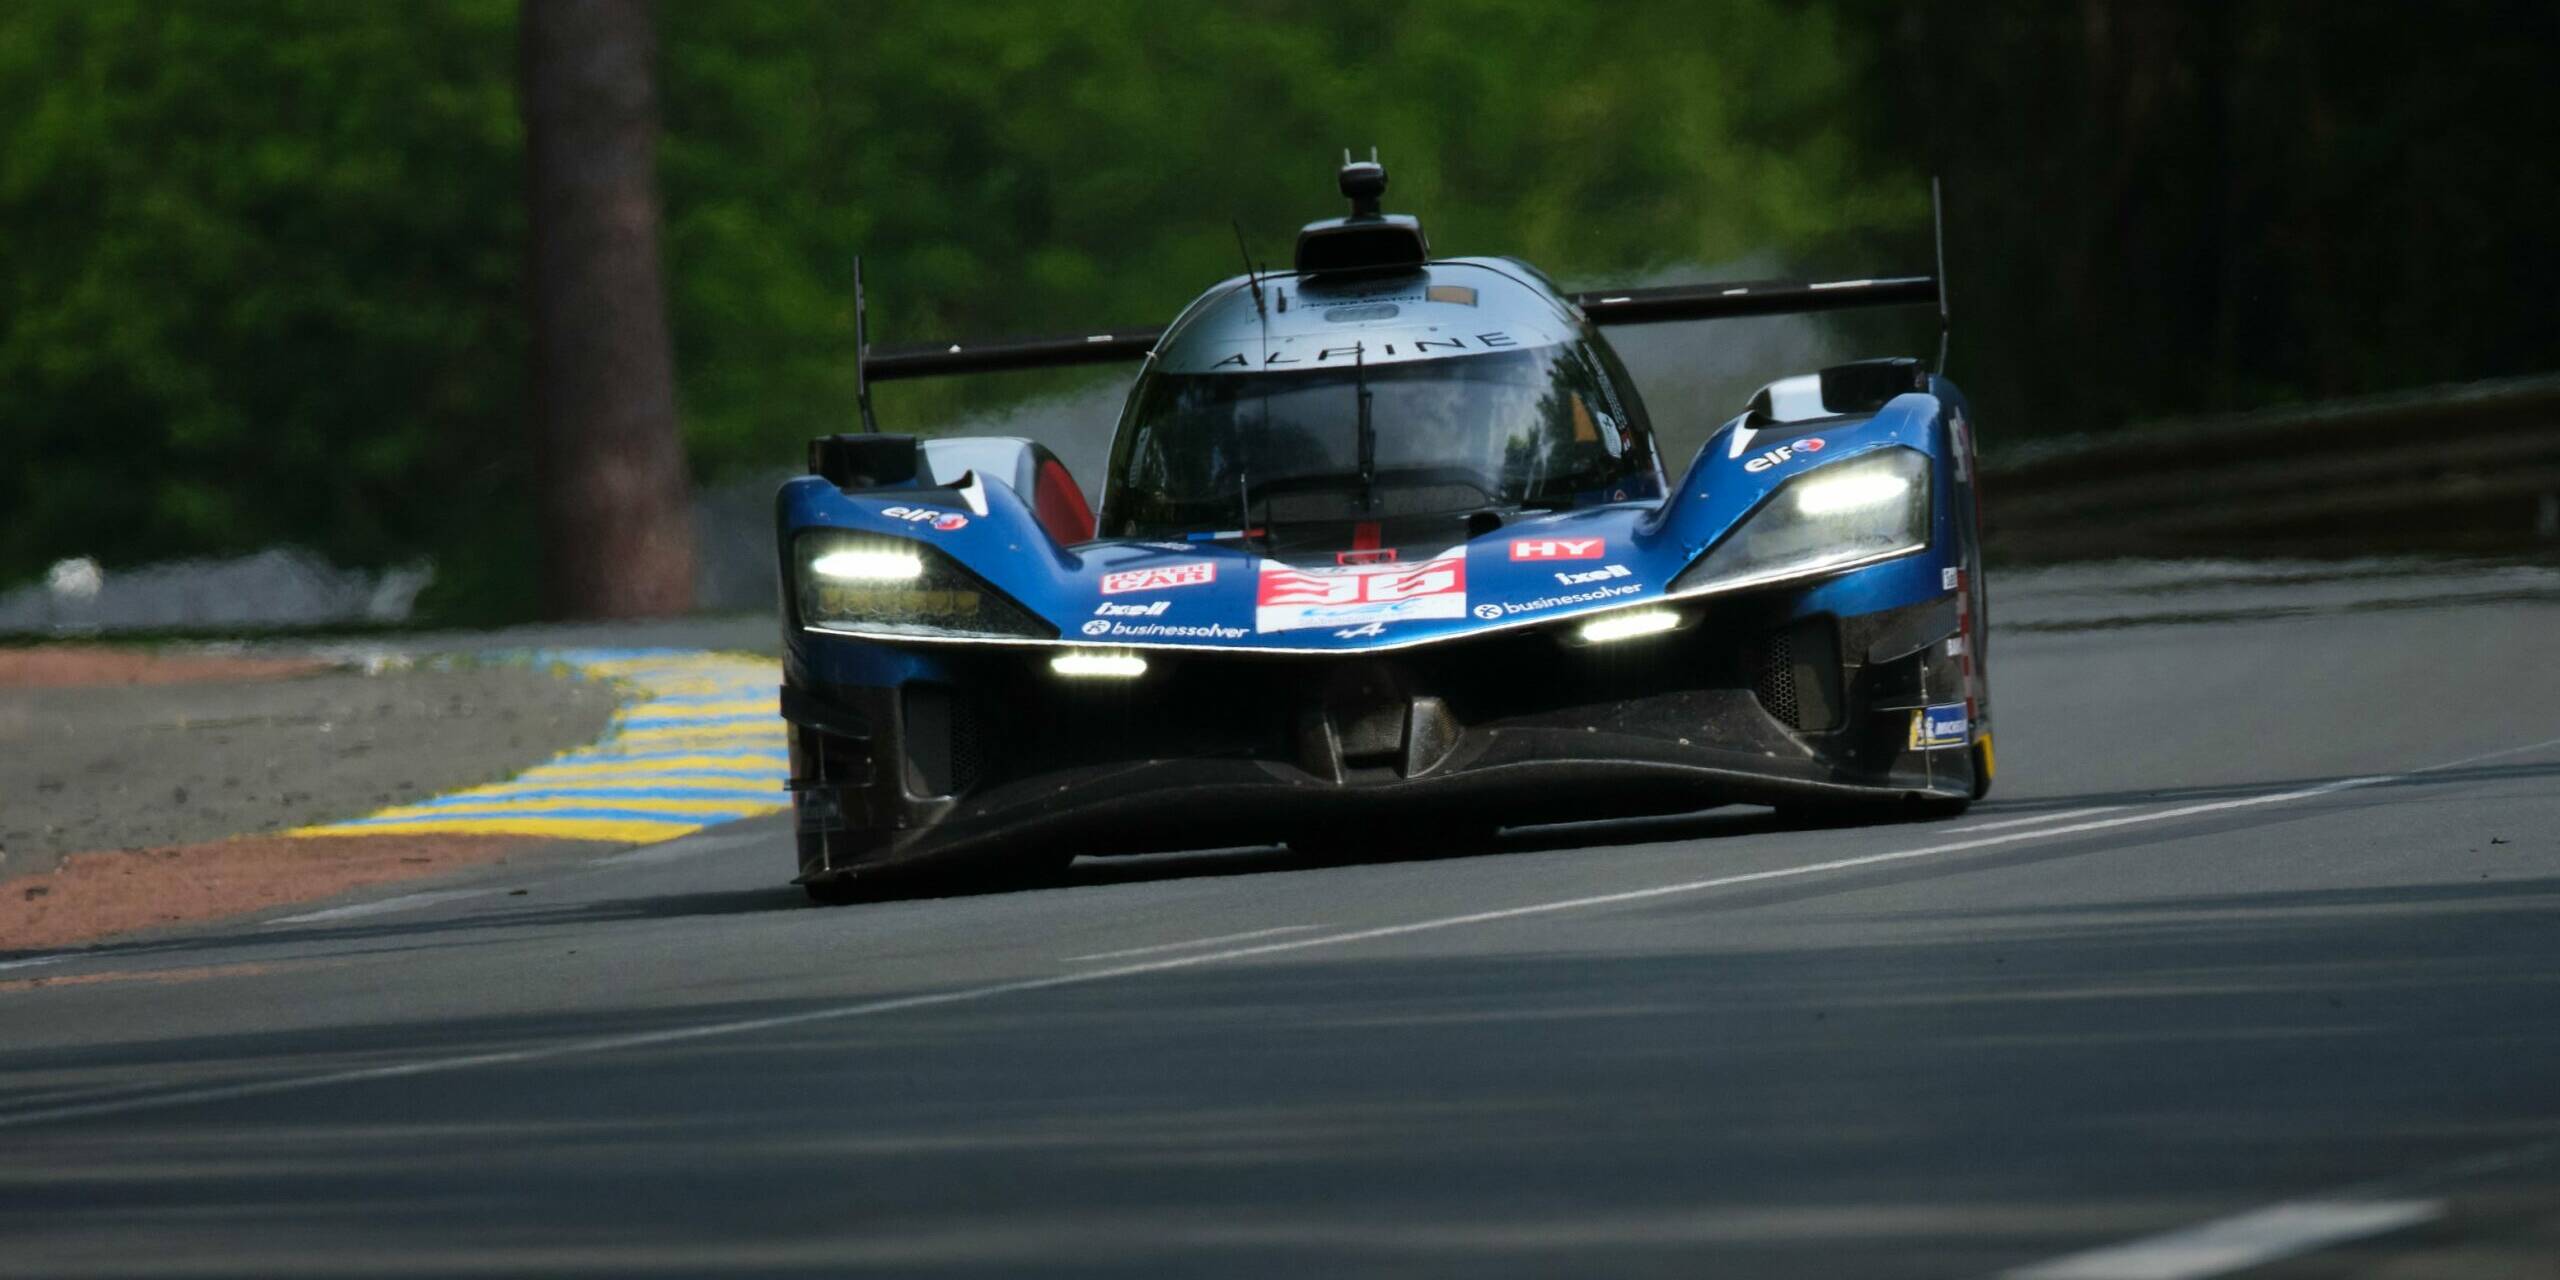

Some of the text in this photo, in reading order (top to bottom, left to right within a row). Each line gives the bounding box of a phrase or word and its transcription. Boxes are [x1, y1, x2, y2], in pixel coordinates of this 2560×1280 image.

[1210, 331, 1517, 370] ALPINE
[1744, 446, 1793, 472] elf
[881, 506, 939, 522] elf
[1516, 540, 1599, 557] HY
[1109, 572, 1204, 590] CAR
[1265, 559, 1455, 604] 36
[1504, 583, 1643, 614] businessolver
[1111, 621, 1250, 639] businessolver
